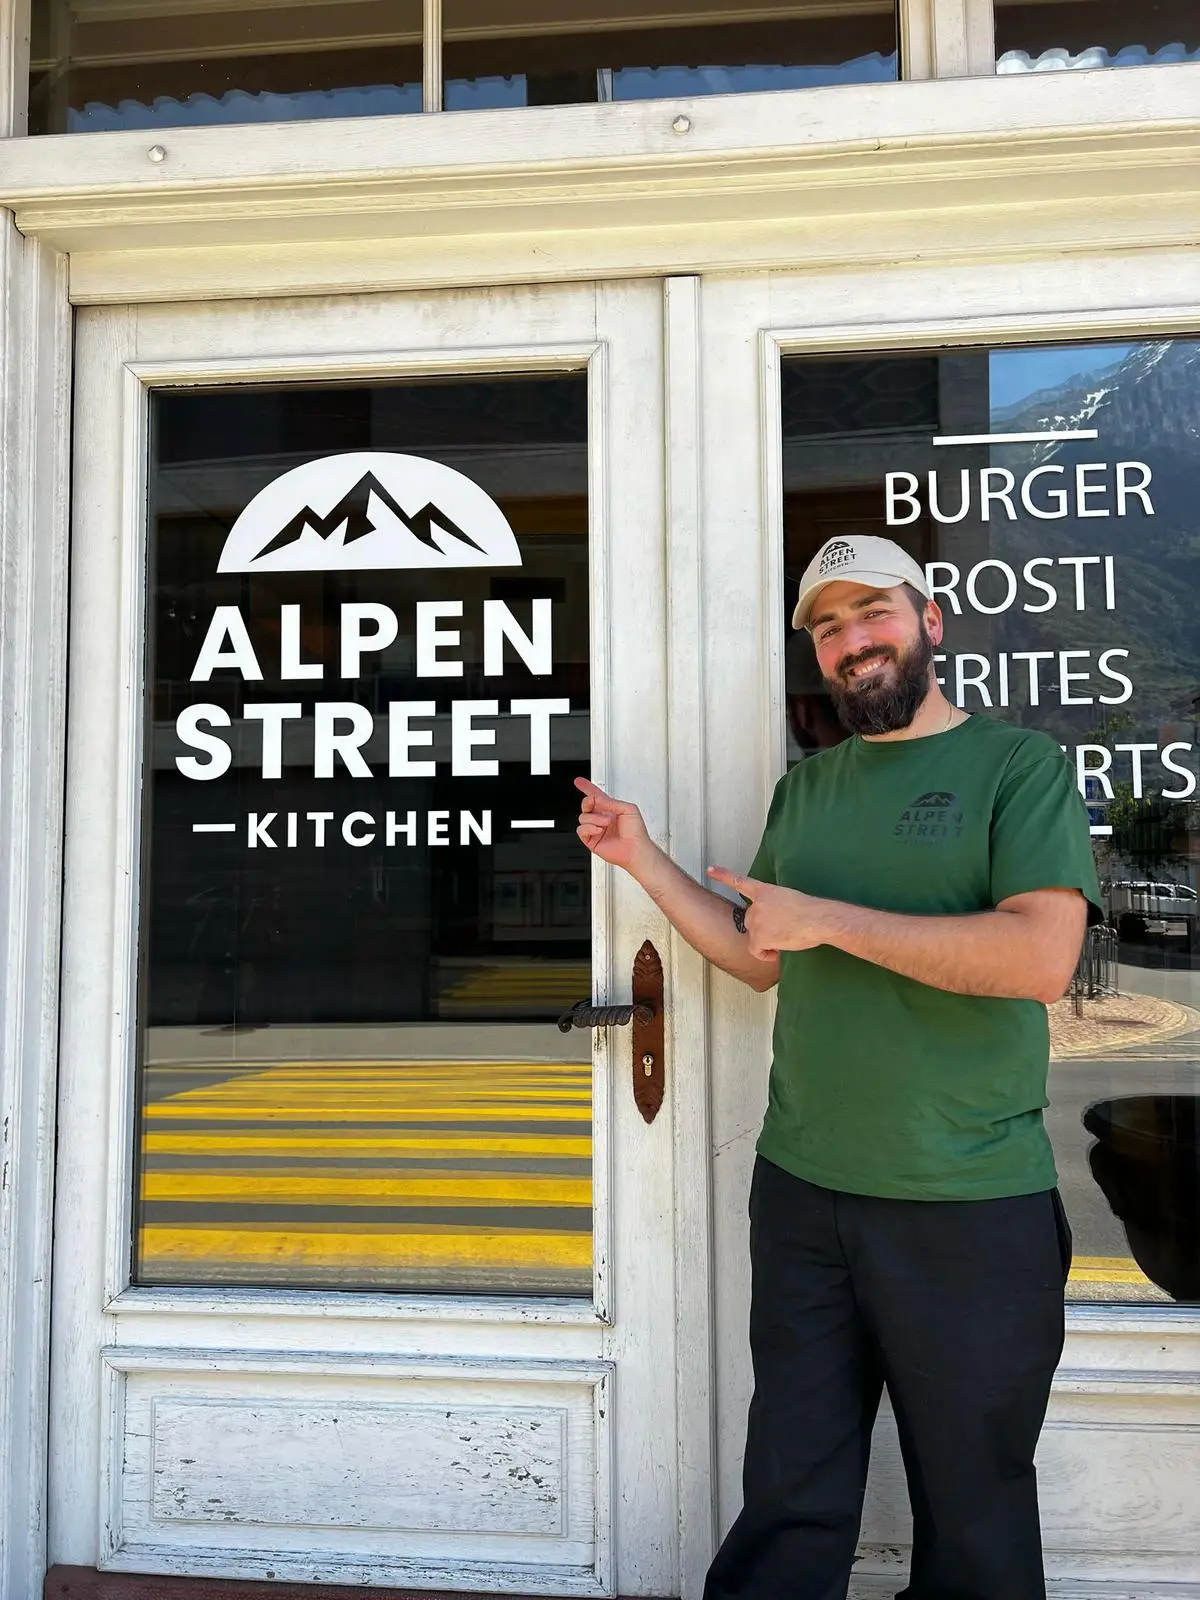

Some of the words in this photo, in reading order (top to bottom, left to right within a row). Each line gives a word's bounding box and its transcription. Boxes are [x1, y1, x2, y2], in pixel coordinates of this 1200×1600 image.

[886, 462, 1155, 525] BURGER
[819, 554, 857, 574] STREET
[820, 548, 854, 567] ALPEN
[925, 556, 1115, 615] ROSTI
[189, 599, 553, 681] ALPEN
[175, 698, 570, 781] STREET
[247, 810, 492, 848] KITCHEN
